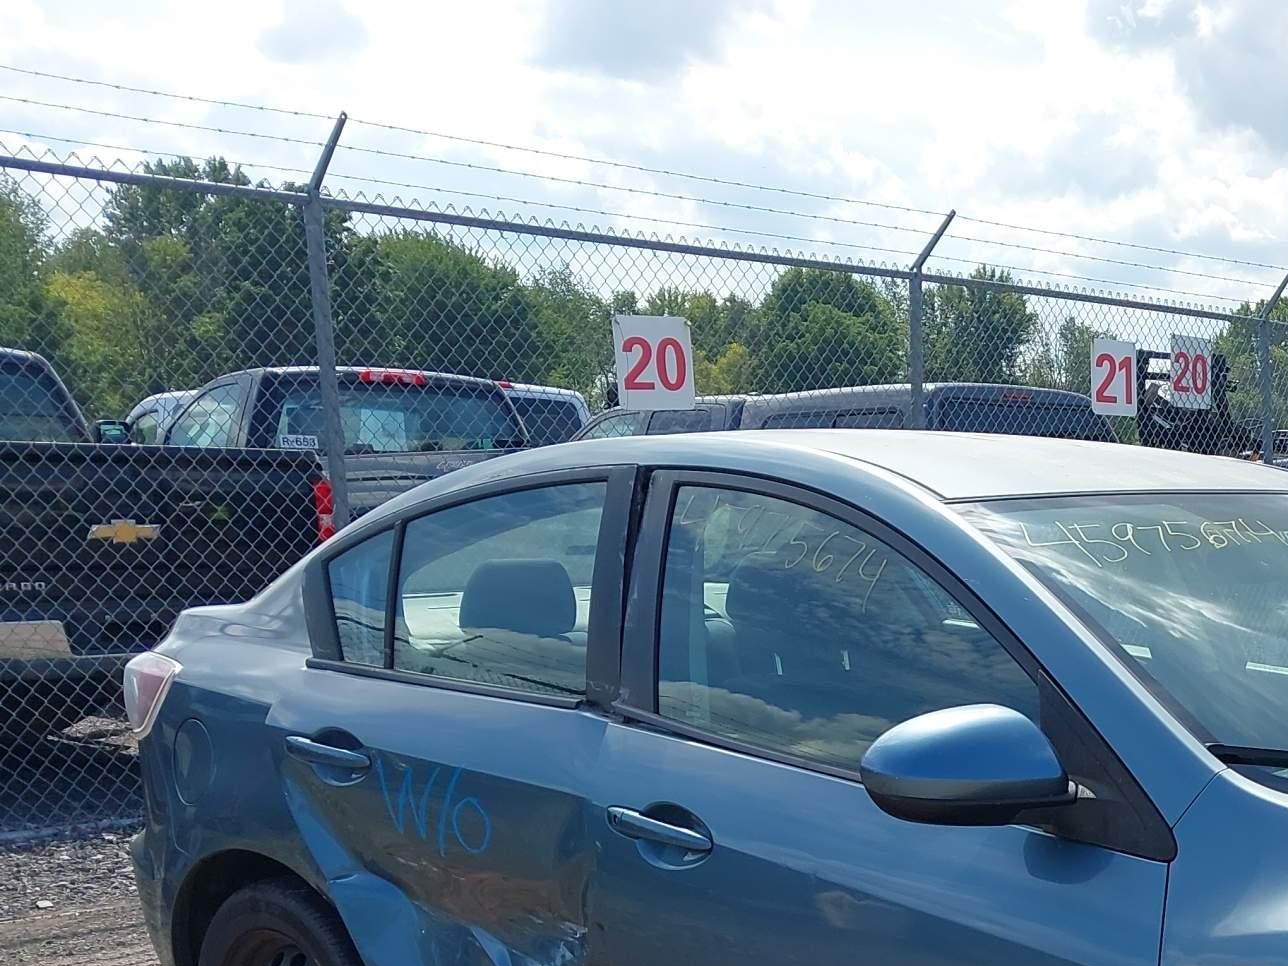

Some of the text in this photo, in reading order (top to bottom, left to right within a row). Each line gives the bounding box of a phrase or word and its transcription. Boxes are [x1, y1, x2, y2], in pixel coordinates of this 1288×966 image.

[622, 336, 686, 391] 20
[1095, 353, 1133, 405] 21
[1173, 351, 1208, 395] 20
